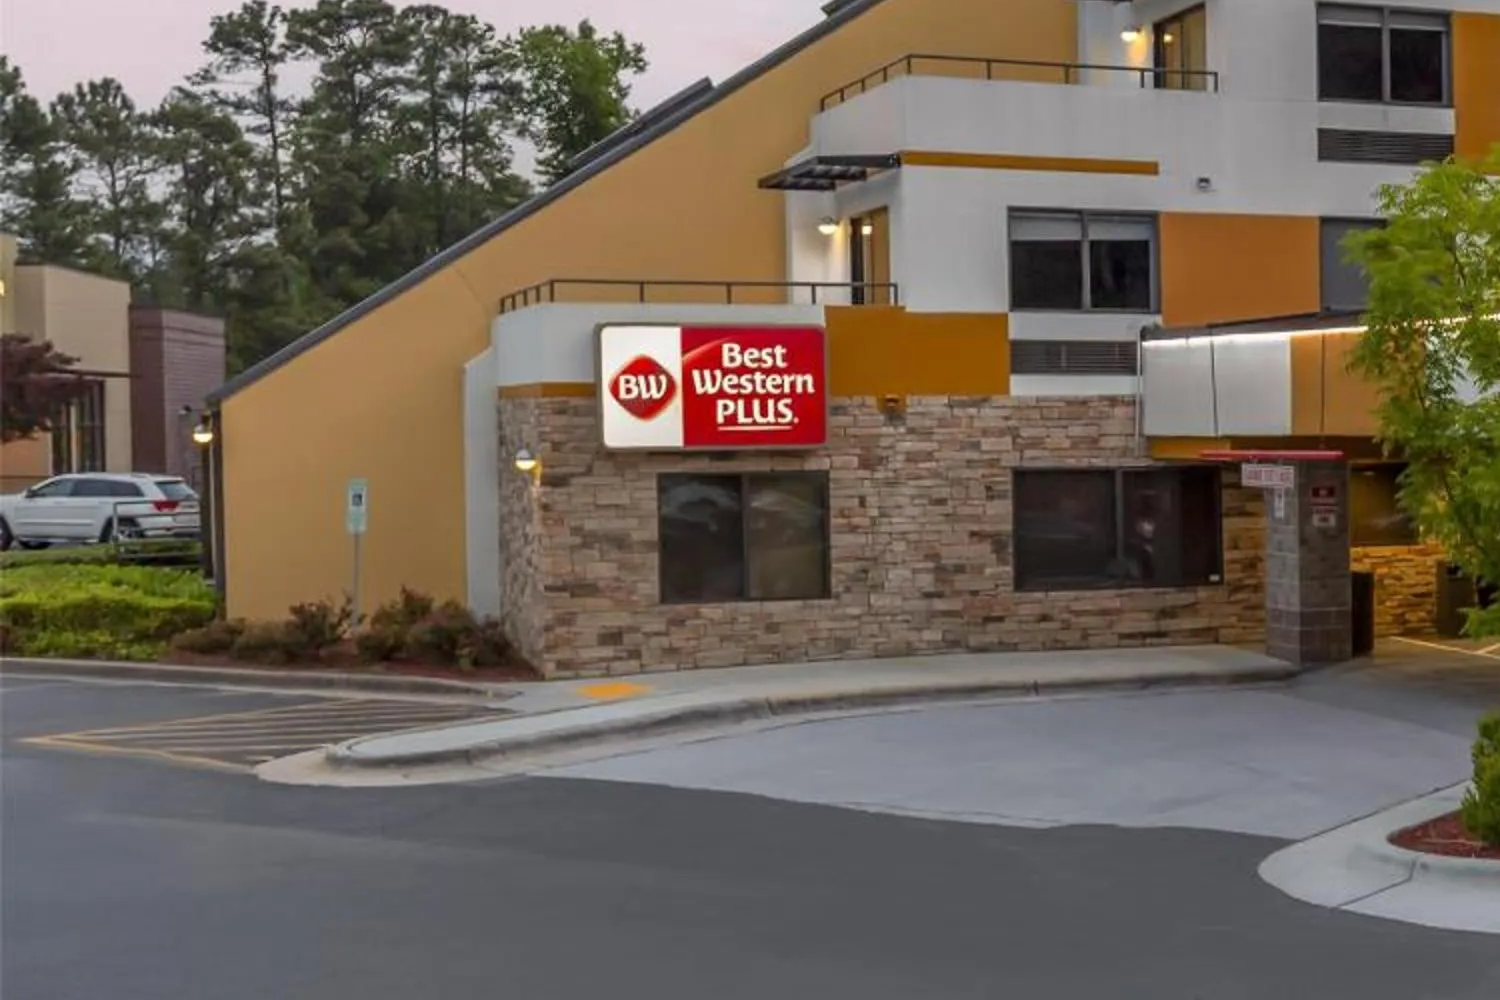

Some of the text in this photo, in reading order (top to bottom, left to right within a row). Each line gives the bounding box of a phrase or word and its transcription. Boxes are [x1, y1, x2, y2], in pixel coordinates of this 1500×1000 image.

[721, 343, 788, 368] Best
[618, 374, 667, 400] BW
[692, 369, 815, 395] Western
